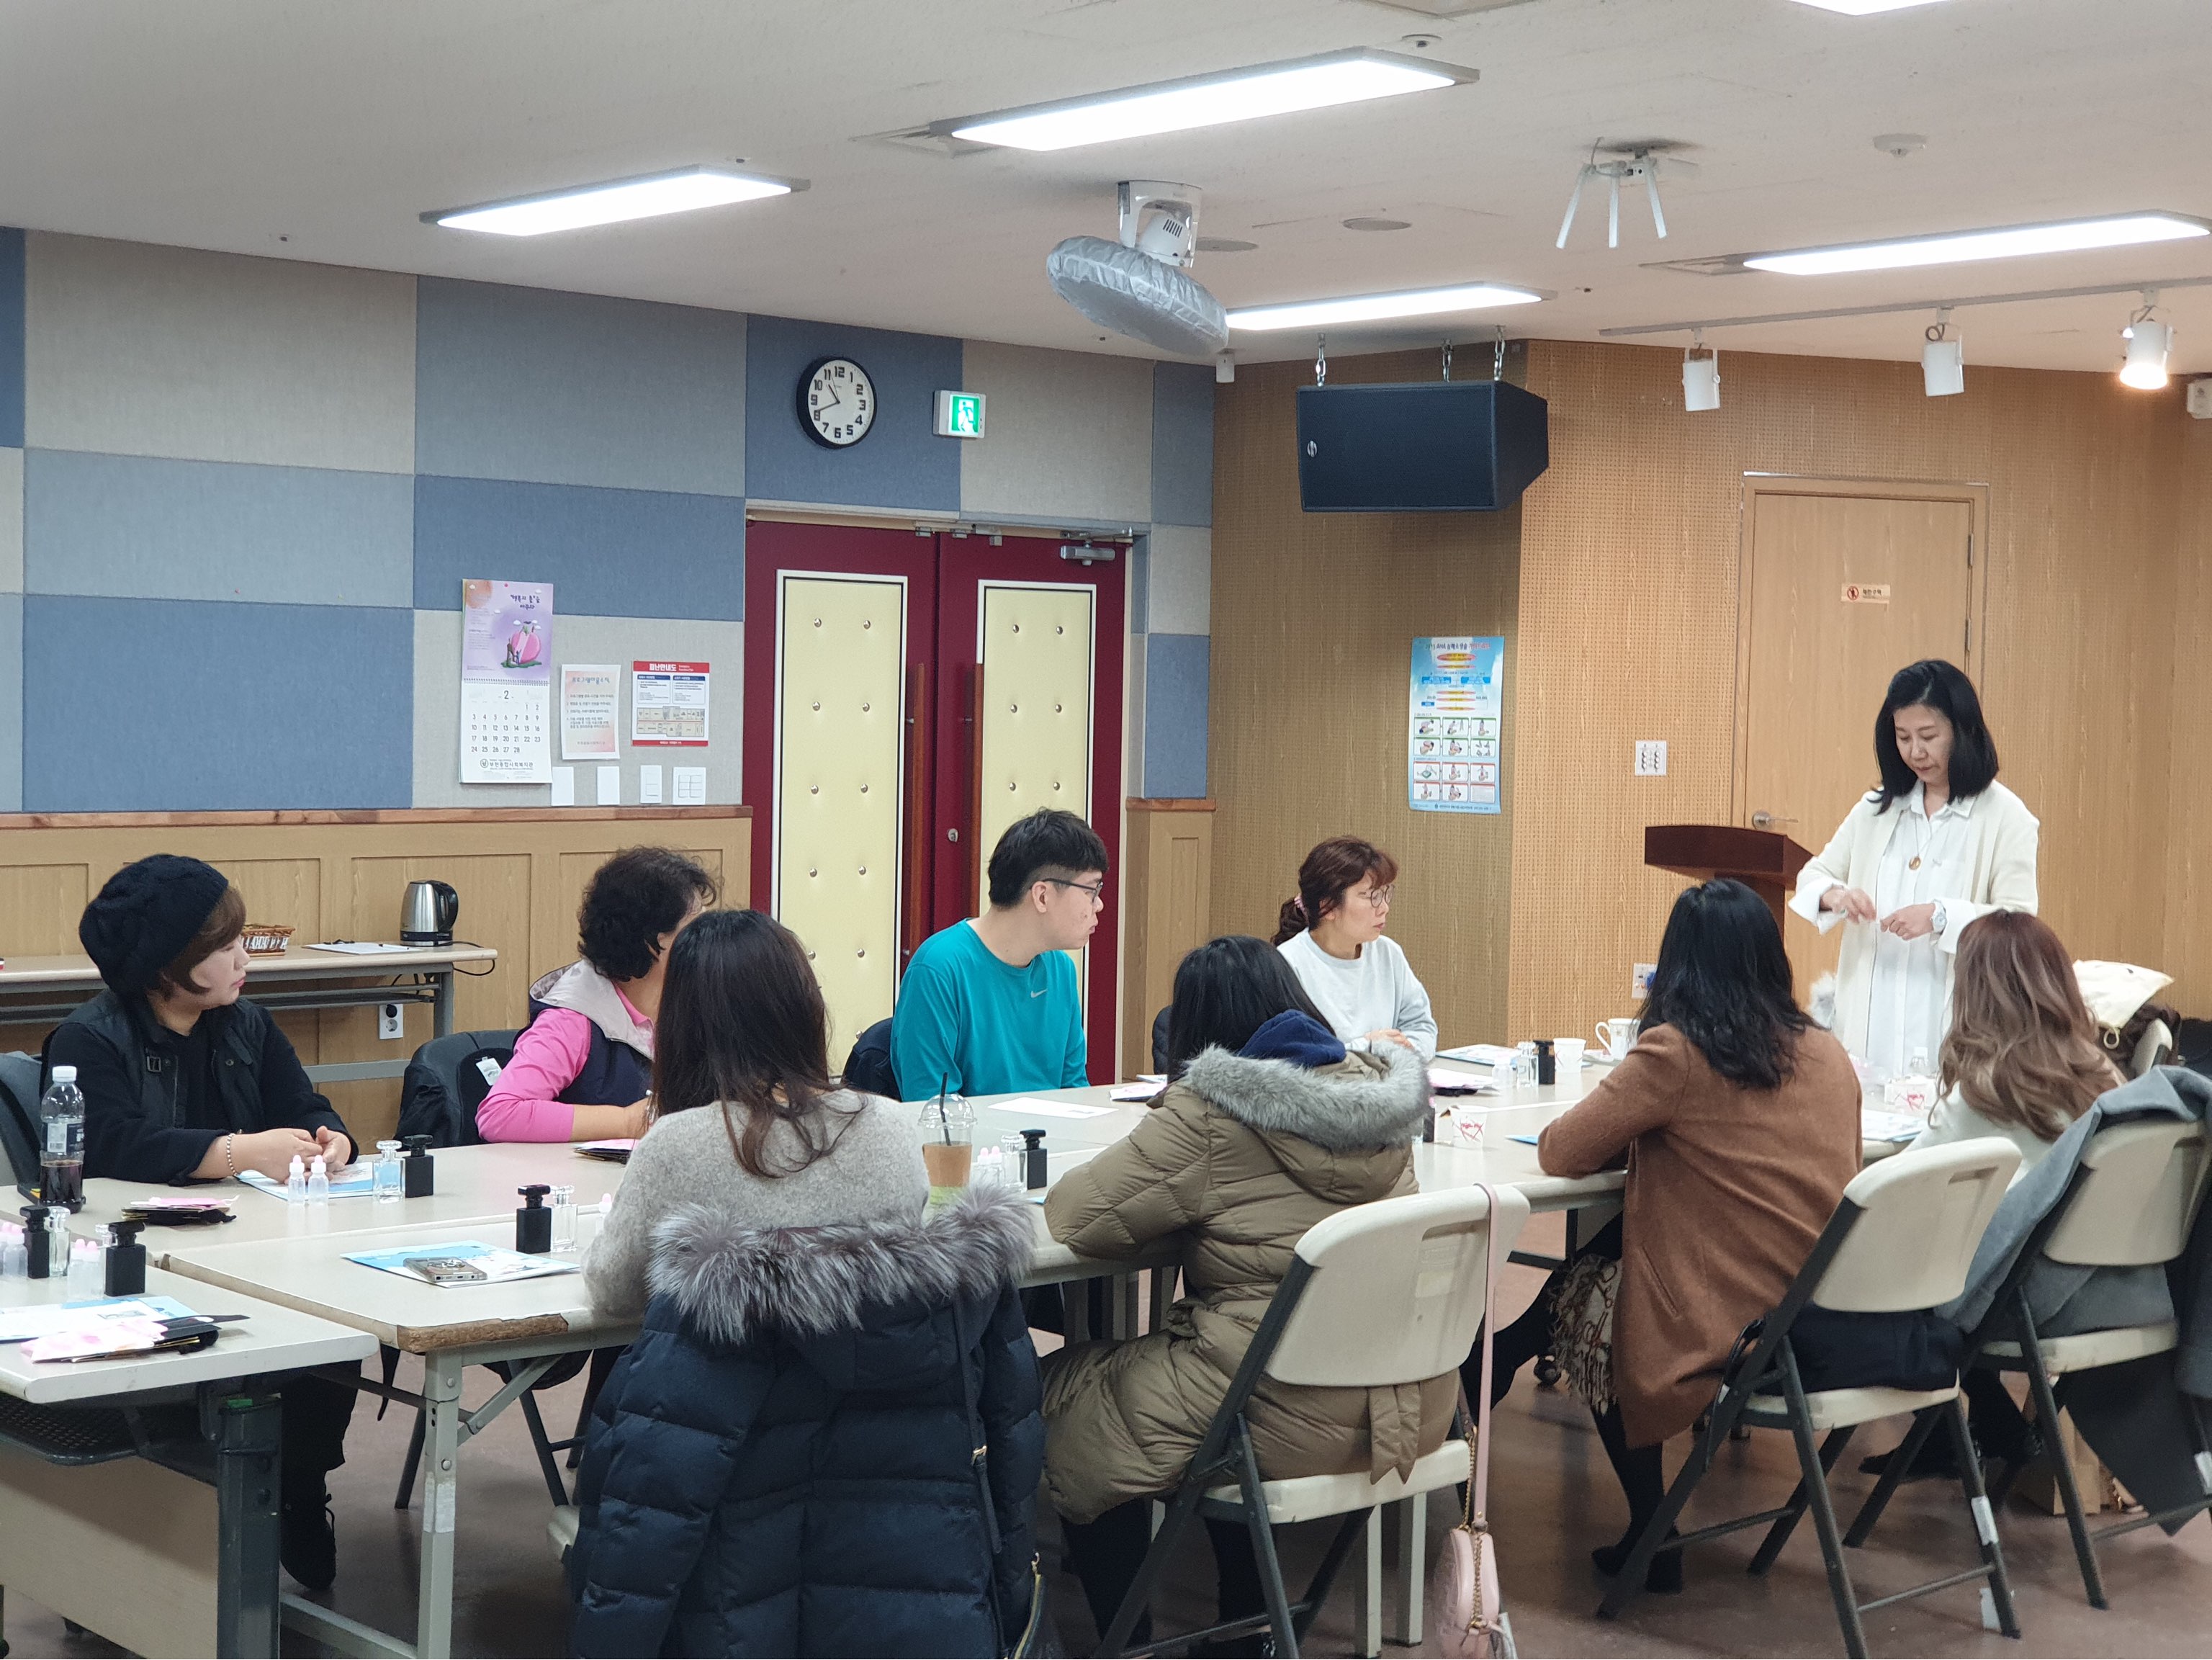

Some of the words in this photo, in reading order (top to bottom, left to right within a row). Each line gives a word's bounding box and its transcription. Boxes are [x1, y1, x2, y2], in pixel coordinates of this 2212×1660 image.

[824, 369, 831, 380] 11
[835, 366, 845, 378] 12
[850, 372, 853, 382] 1
[814, 380, 822, 390] 10
[856, 384, 863, 395] 2
[811, 394, 818, 405] 9
[859, 400, 866, 410] 3
[814, 410, 821, 421] 8
[855, 414, 863, 425] 4
[822, 422, 829, 433] 7
[835, 427, 841, 438] 6
[846, 425, 853, 435] 5
[504, 690, 509, 700] 2
